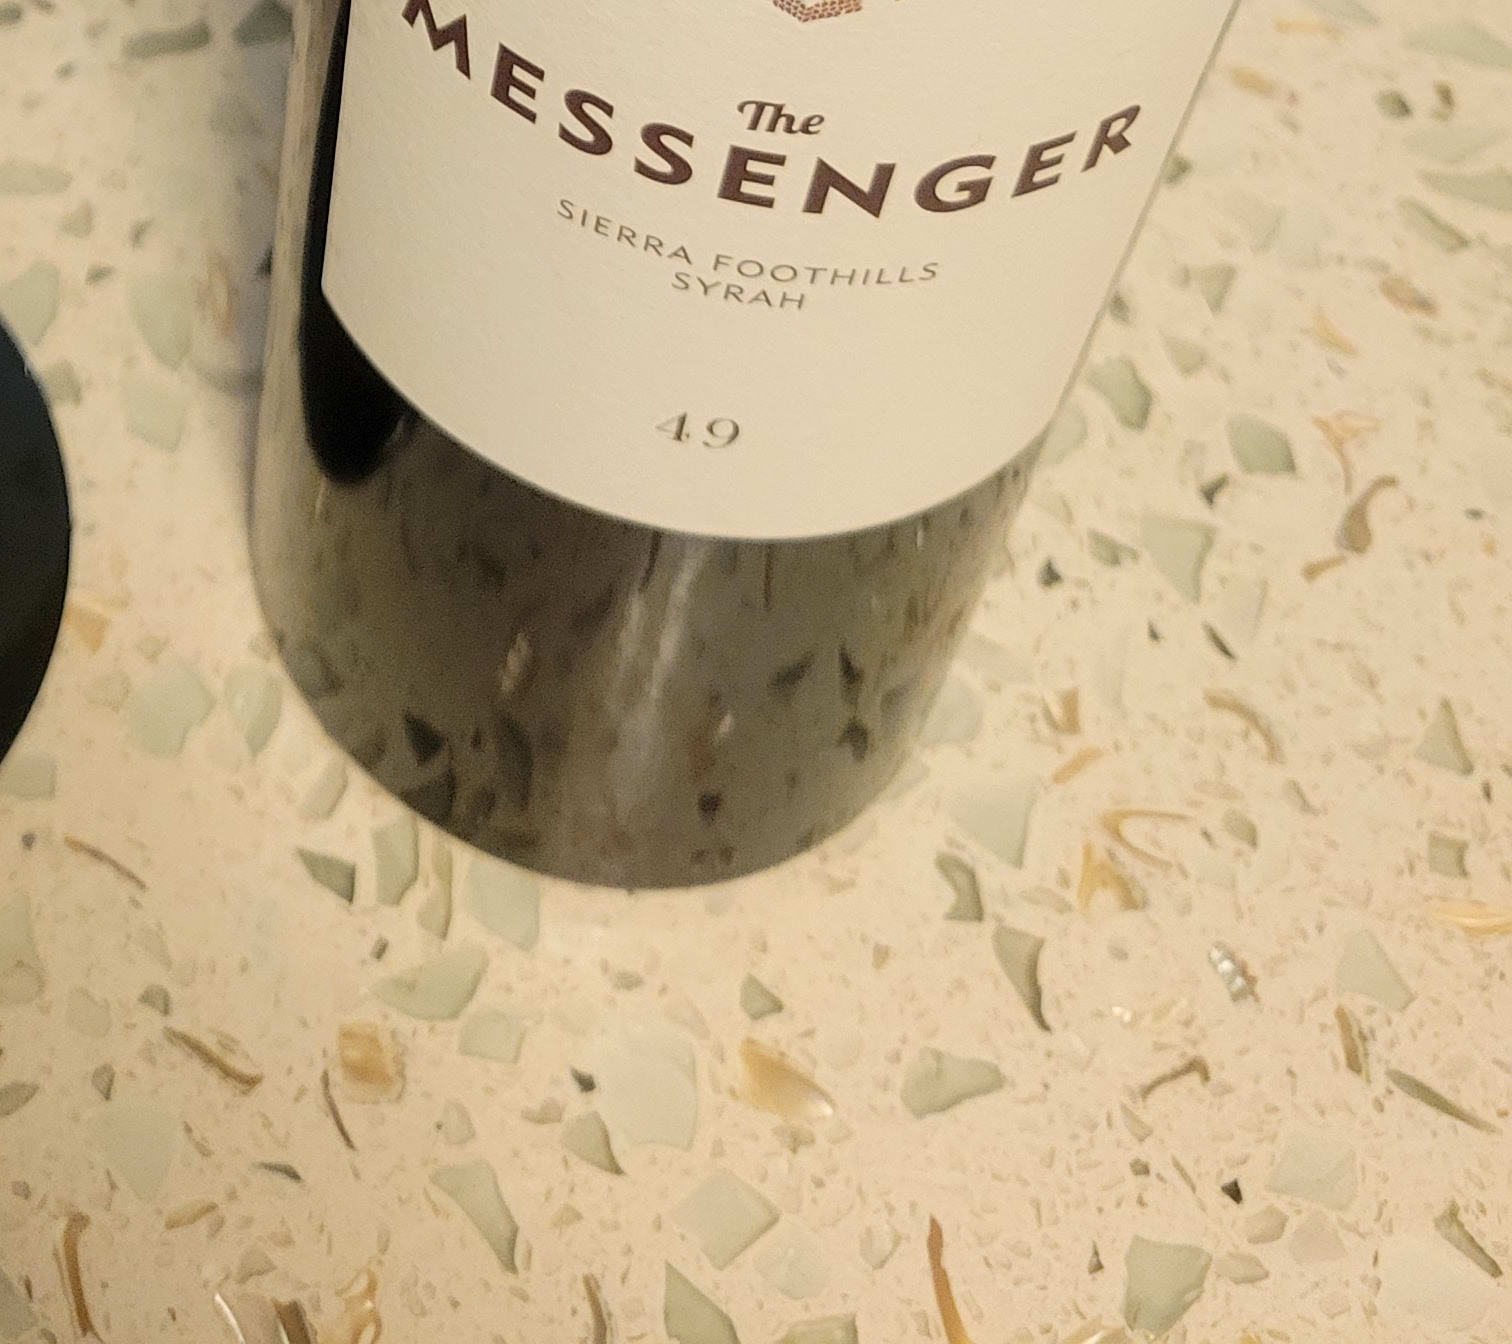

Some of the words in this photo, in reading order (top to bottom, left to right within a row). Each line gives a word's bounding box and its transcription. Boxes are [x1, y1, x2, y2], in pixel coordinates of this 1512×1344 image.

[737, 99, 826, 135] The
[557, 198, 692, 265] SIERRA
[712, 254, 938, 286] FOOTHILLS
[671, 271, 806, 310] SYRAH
[654, 411, 740, 449] 49
